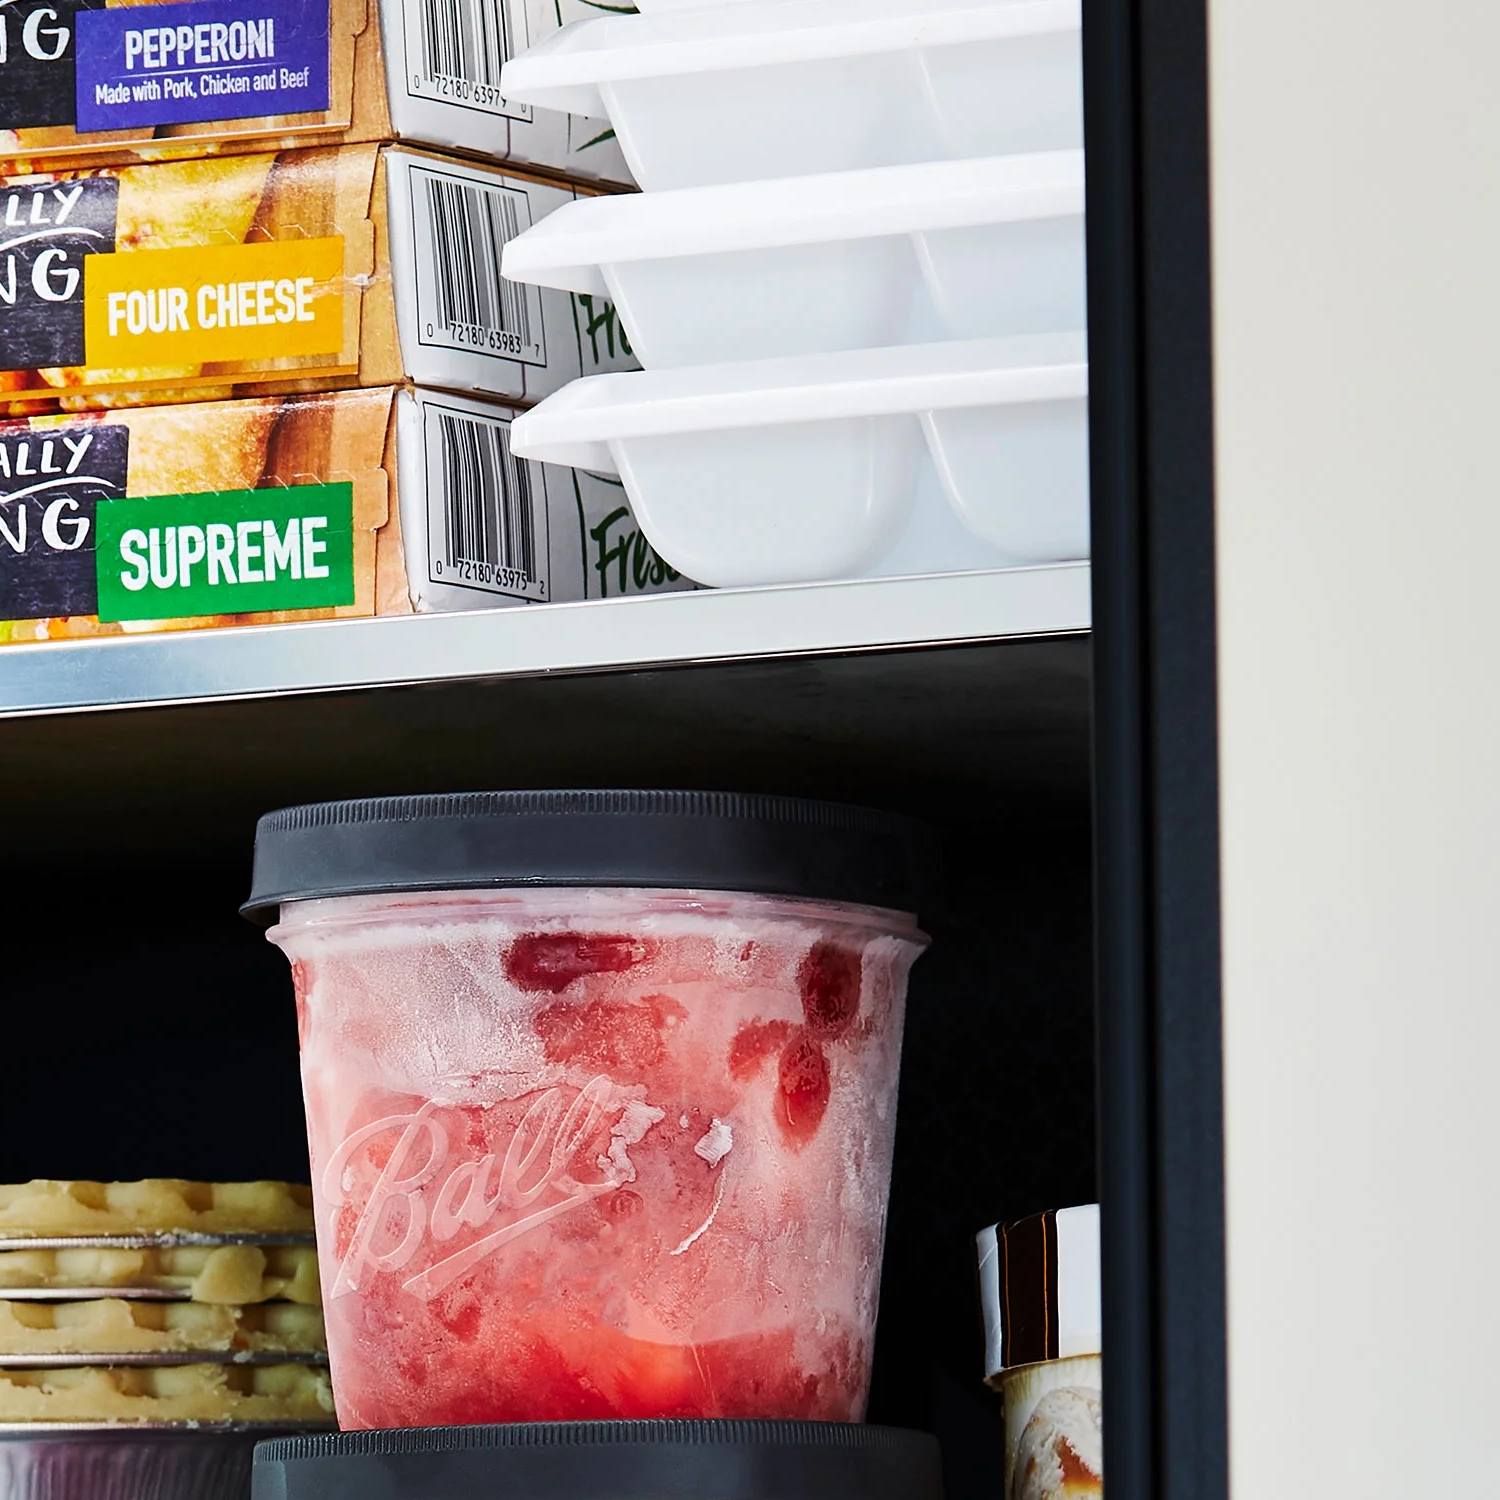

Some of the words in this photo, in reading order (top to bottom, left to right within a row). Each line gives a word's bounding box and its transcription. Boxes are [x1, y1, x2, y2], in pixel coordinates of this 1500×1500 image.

[125, 18, 275, 70] PEPPERONI
[96, 81, 131, 105] Made
[133, 80, 161, 101] with
[164, 77, 198, 99] Pork,
[201, 73, 250, 96] Chicken
[253, 69, 277, 91] and
[280, 66, 310, 89] Beef
[413, 74, 421, 89] 0
[434, 75, 469, 100] 72180
[108, 289, 189, 337] FOUR
[196, 277, 315, 328] CHEESE
[426, 323, 434, 338] 0
[450, 321, 485, 347] 72180
[489, 328, 522, 354] 63983
[119, 516, 329, 592] SUPREME
[435, 561, 443, 575] 0
[457, 558, 492, 582] 72180
[495, 566, 528, 591] 63975
[323, 1074, 620, 1299] Ball
